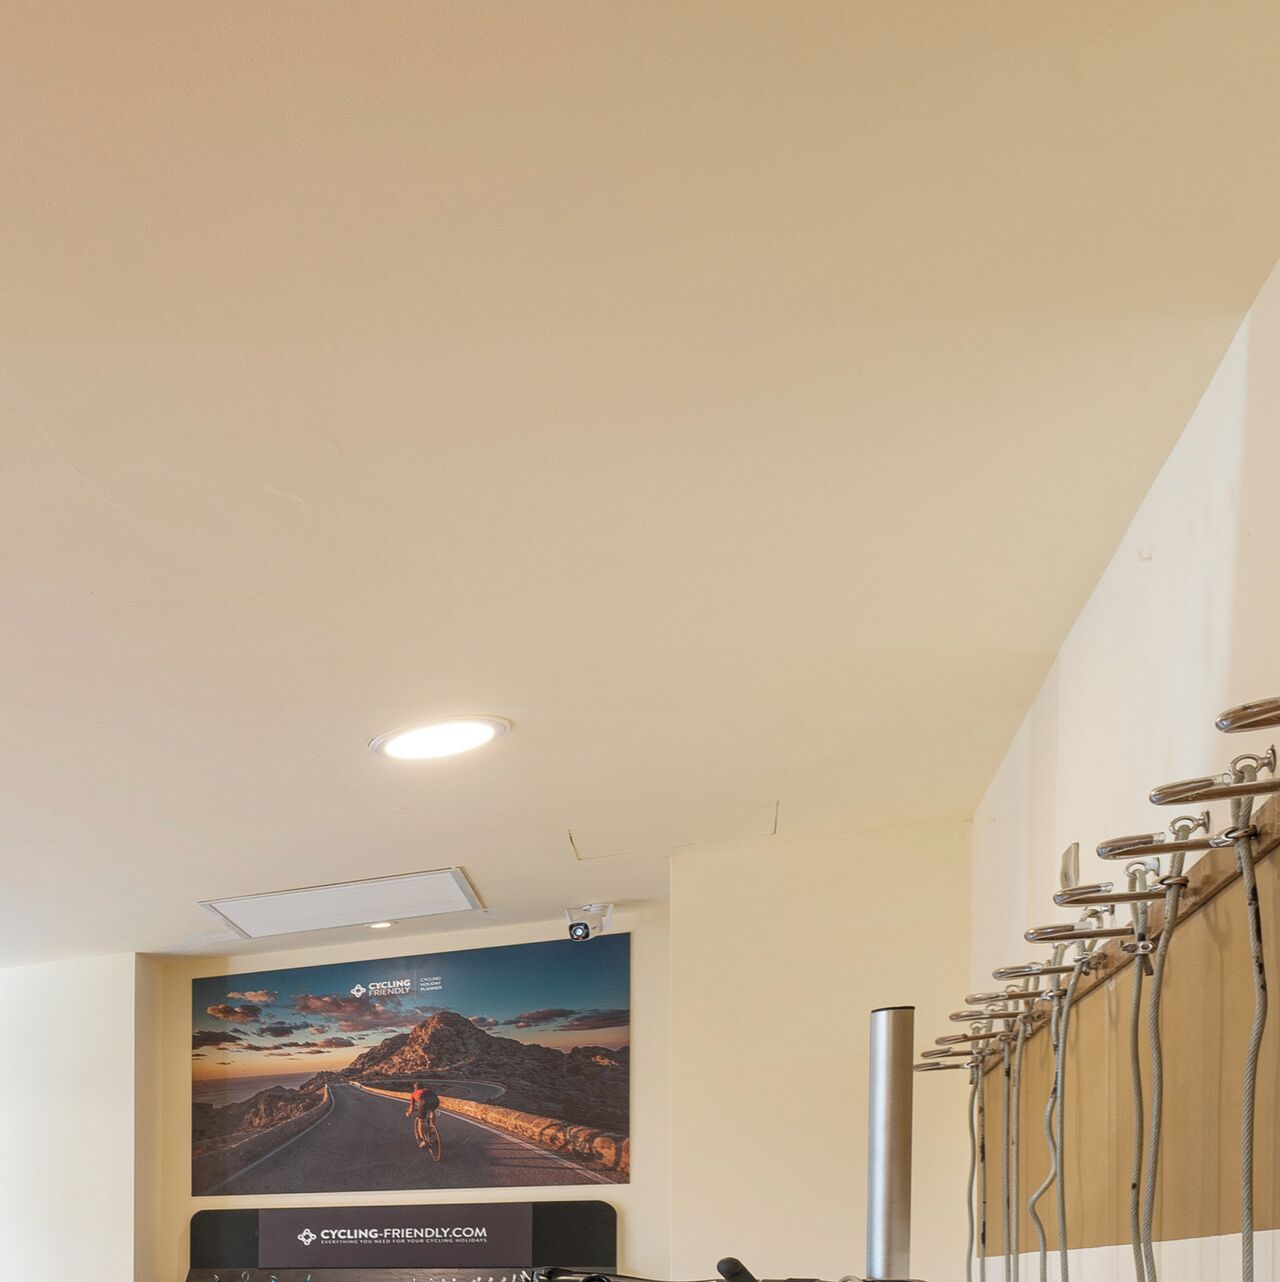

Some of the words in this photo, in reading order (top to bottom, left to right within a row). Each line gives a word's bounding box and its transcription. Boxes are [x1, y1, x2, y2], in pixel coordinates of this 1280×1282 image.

[368, 979, 411, 990] CYCLING
[368, 987, 411, 997] FRIENDLY
[320, 1227, 488, 1239] CYCLING-FRIENDLY.COM
